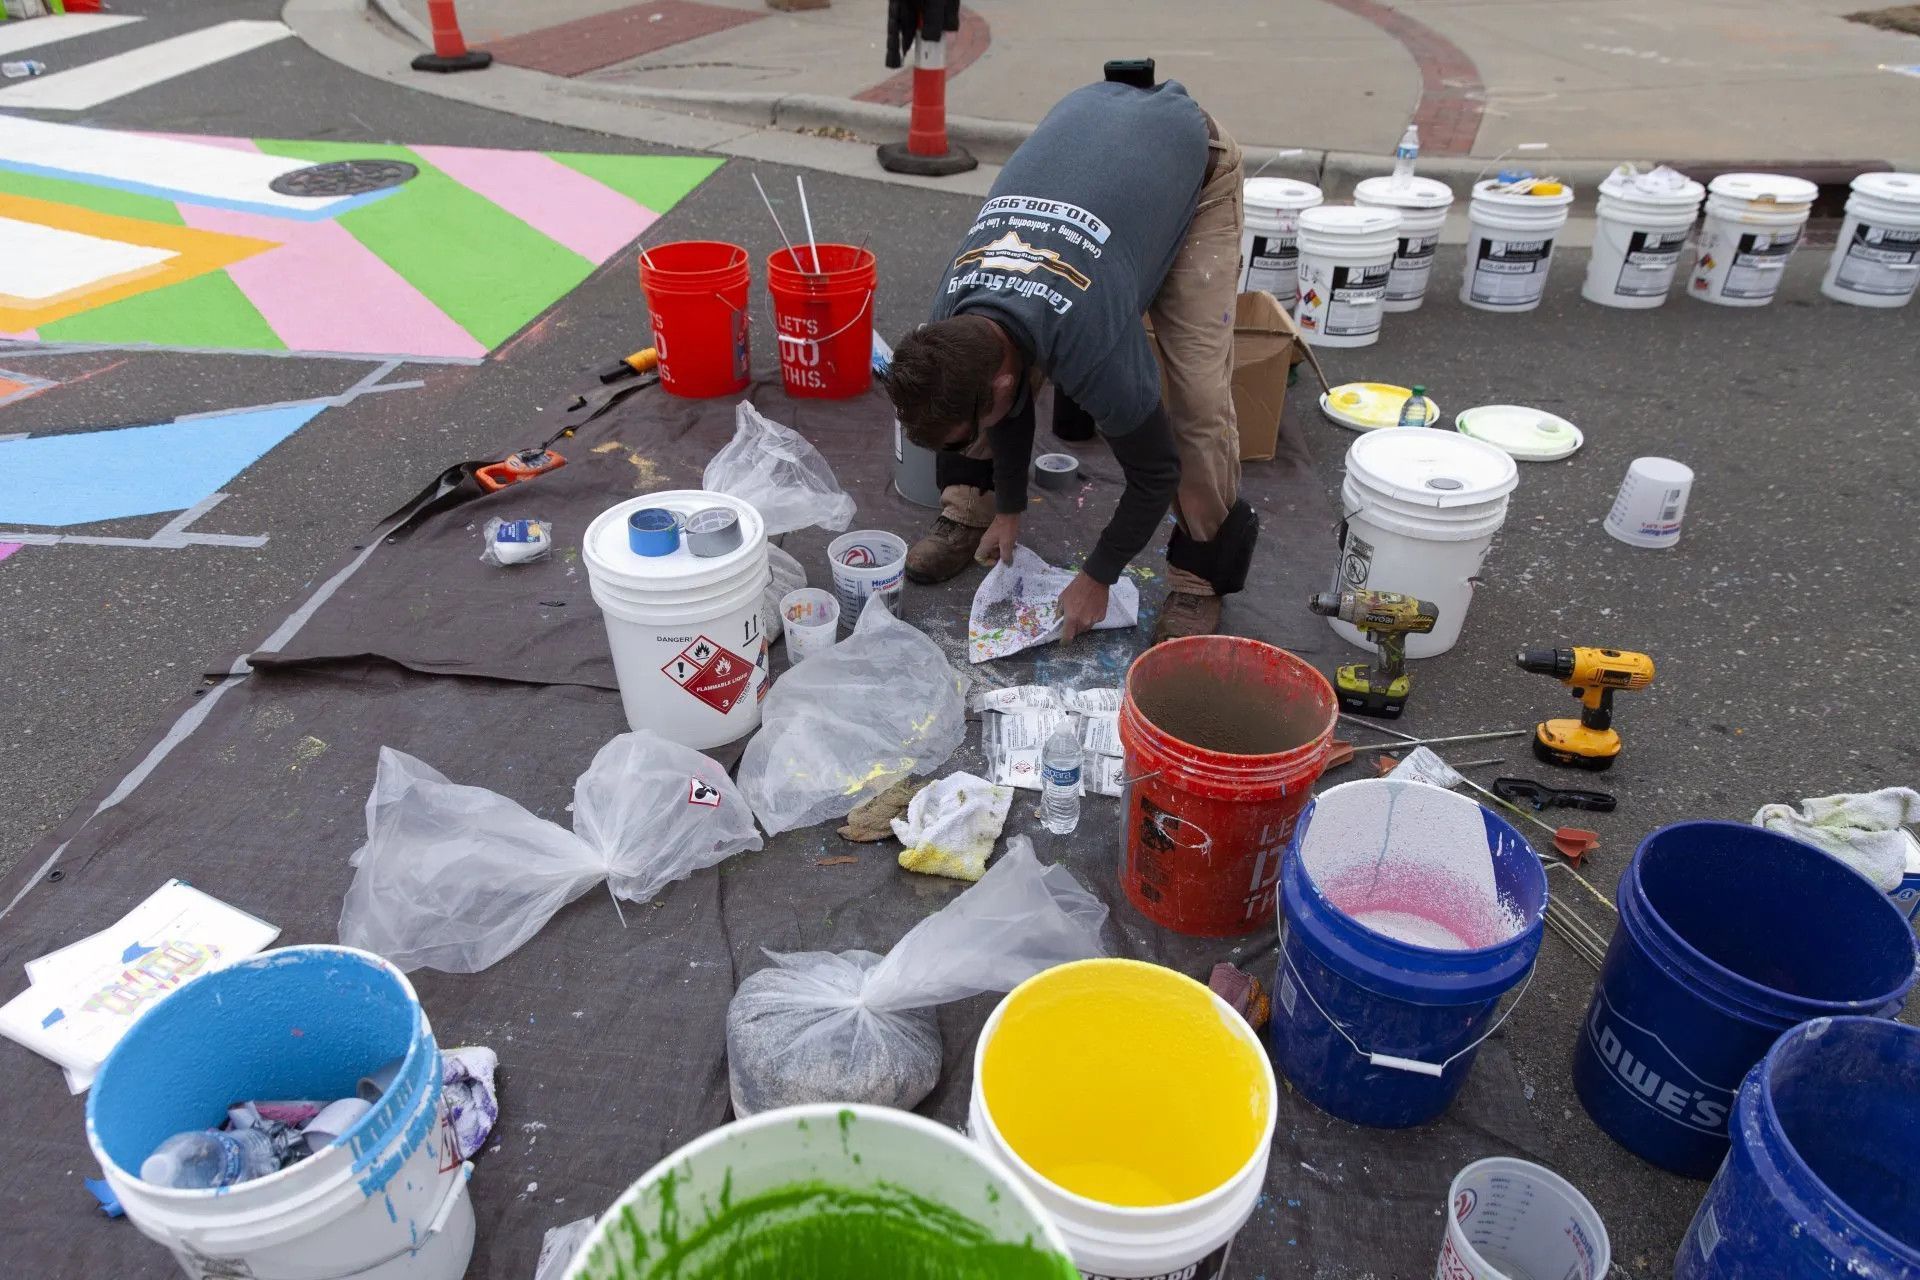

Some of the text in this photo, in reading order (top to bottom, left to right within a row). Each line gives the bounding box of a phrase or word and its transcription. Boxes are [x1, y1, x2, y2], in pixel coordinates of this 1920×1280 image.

[1008, 215, 1051, 233] Sealcoating
[1058, 224, 1085, 246] Filling
[1081, 239, 1102, 259] Crack
[947, 270, 1073, 315] Carolina Stripg
[778, 312, 818, 336] LET'S
[783, 363, 827, 389] THIS.
[1367, 614, 1395, 625] RYOBI
[696, 672, 749, 692] FLAMMABLE LIQUID
[722, 699, 729, 707] 3
[1590, 998, 1728, 1128] LOWE'S
